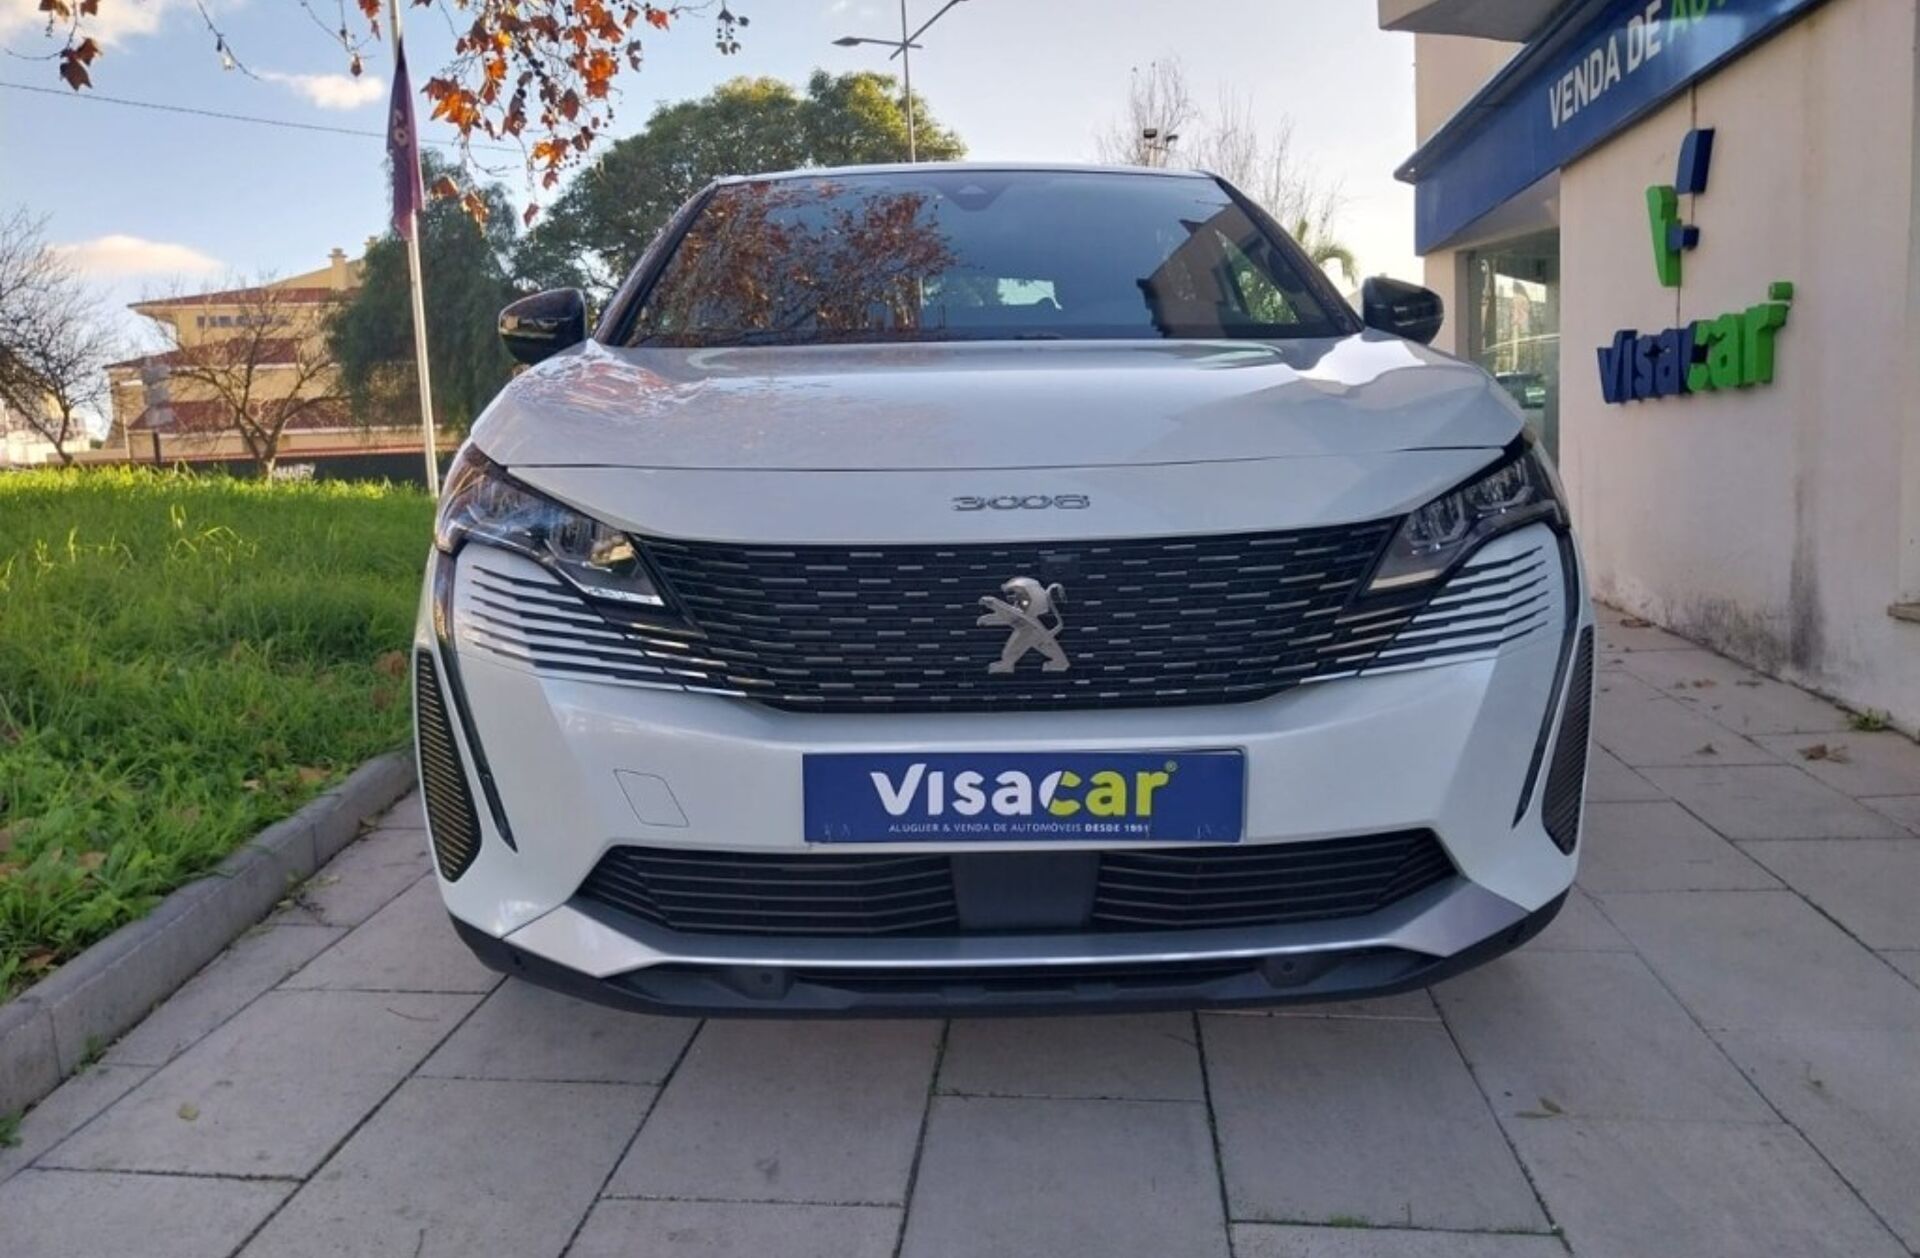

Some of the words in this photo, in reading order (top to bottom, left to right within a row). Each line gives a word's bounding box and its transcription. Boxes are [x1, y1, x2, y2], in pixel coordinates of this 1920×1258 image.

[1549, 34, 1621, 130] VENDA
[1626, 0, 1662, 74] DE
[952, 494, 1091, 512] 3008
[888, 823, 939, 833] ALUGUER
[954, 823, 990, 833] VENDA
[993, 823, 1008, 833] DE
[1084, 823, 1121, 833] DESDE
